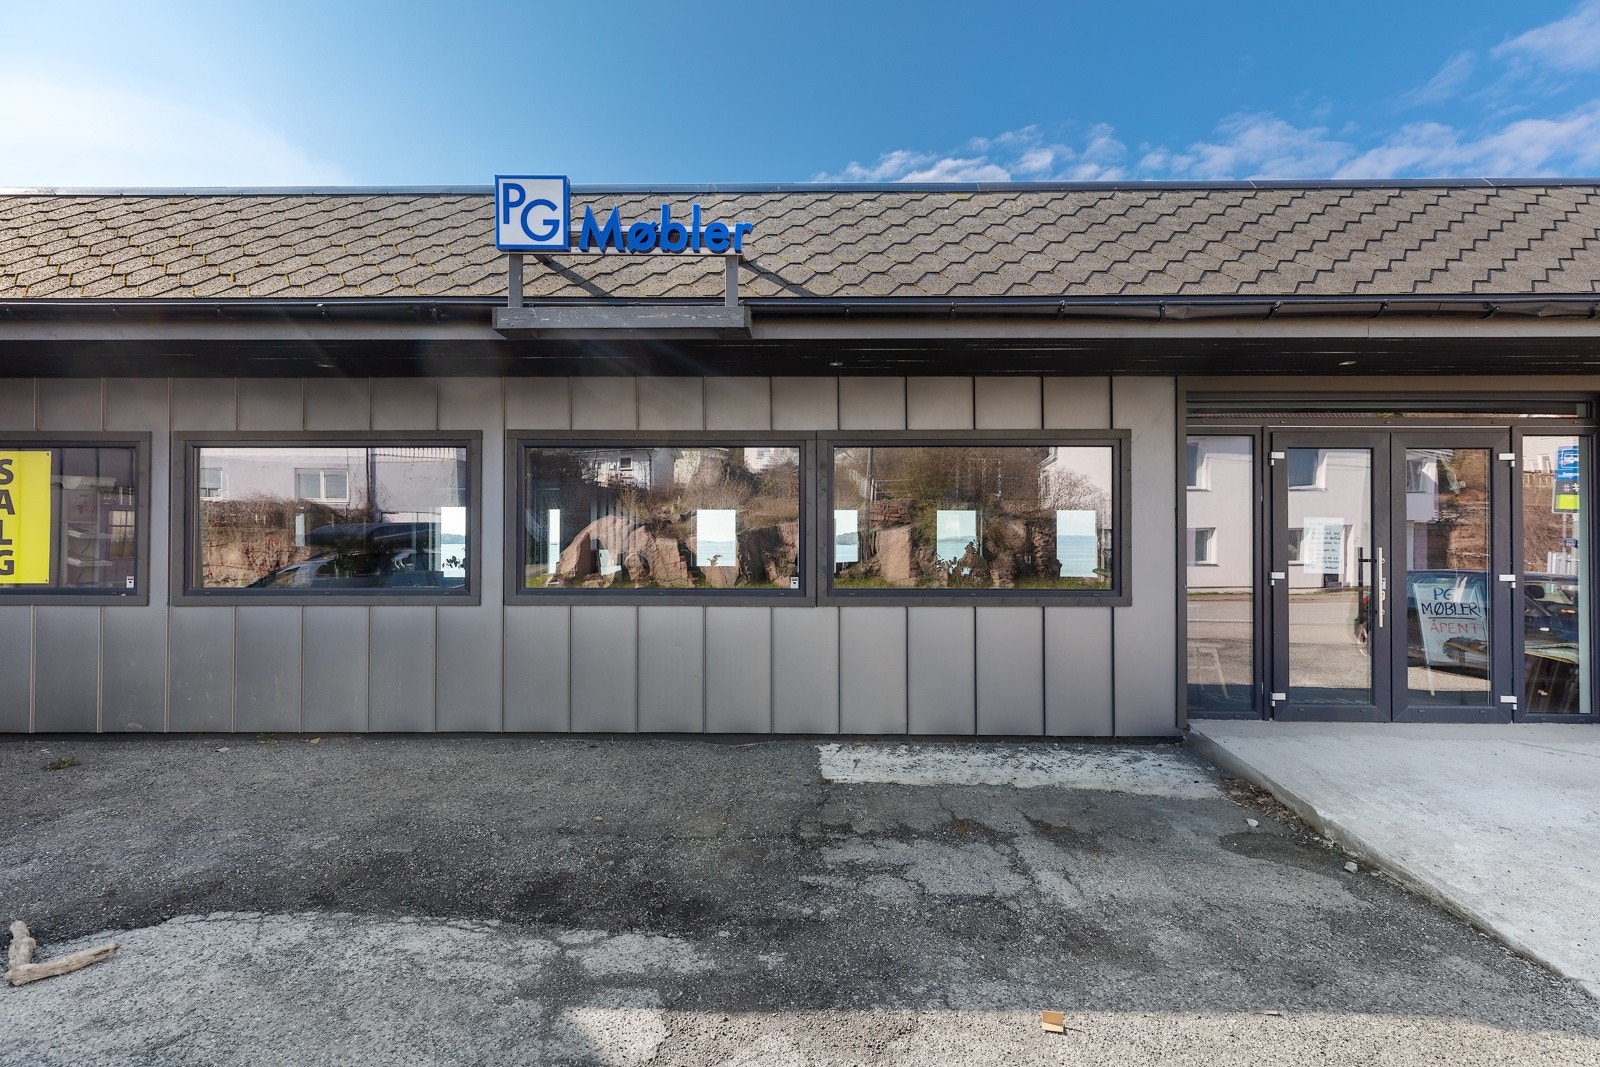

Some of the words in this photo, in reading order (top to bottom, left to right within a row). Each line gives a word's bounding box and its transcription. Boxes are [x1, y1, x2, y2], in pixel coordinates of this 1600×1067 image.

[502, 183, 560, 242] PG
[578, 203, 753, 254] Møbler
[1421, 602, 1482, 617] MØBLER
[1430, 619, 1482, 634] ÅPENT
